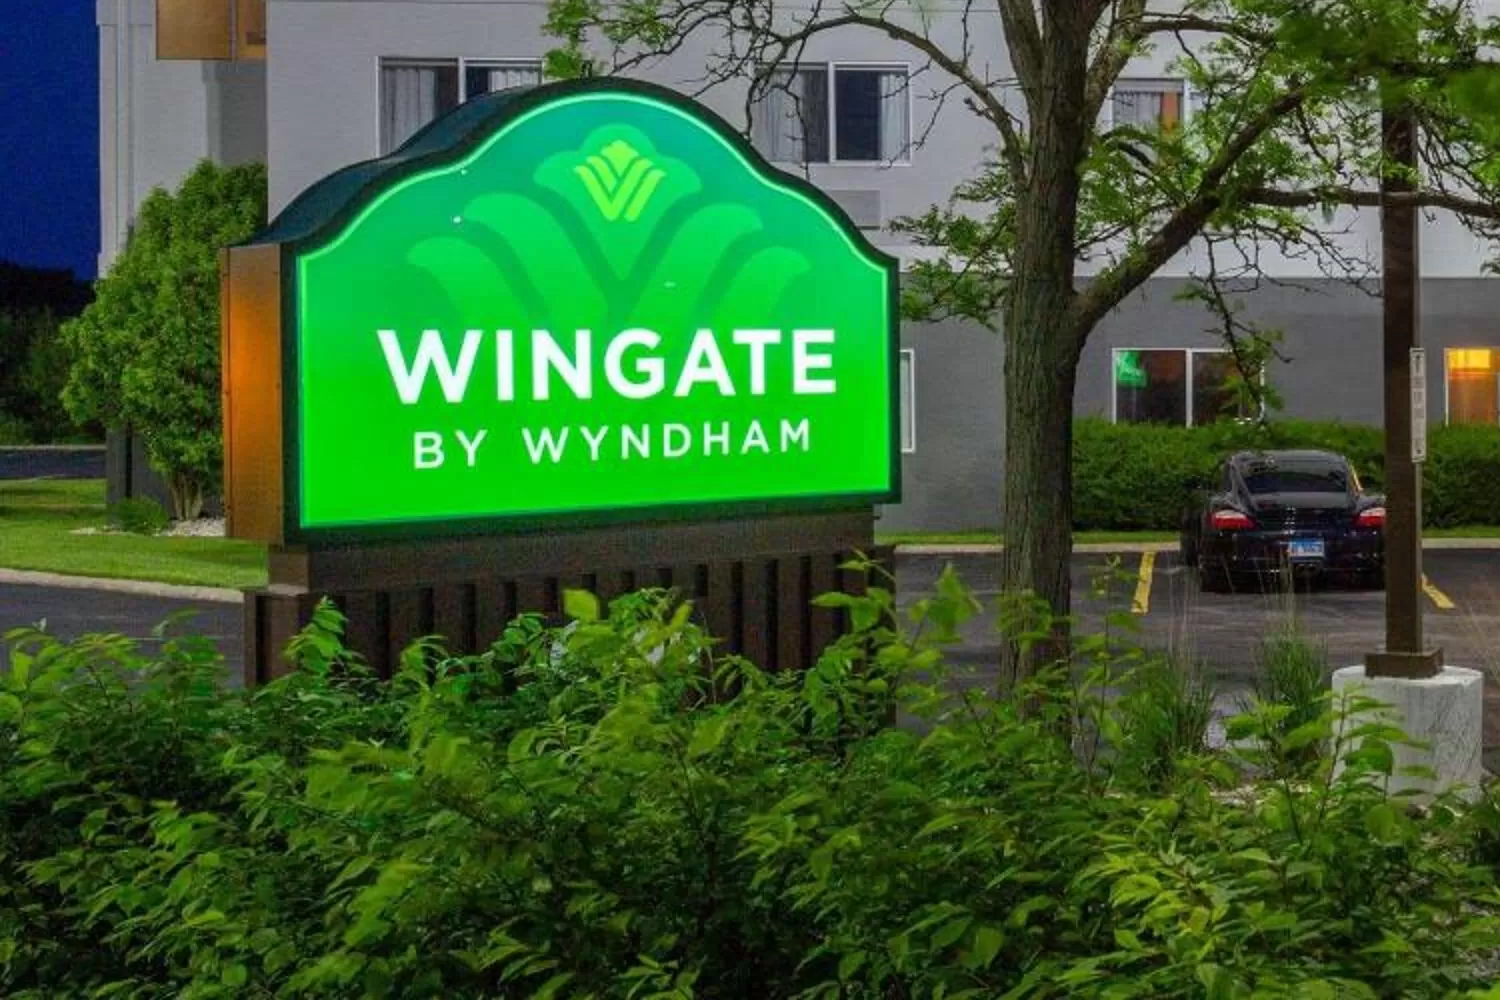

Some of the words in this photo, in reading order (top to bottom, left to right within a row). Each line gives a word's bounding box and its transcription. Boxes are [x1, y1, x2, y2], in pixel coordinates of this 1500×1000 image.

[377, 328, 837, 404] WINGATE
[413, 430, 487, 469] BY
[523, 418, 810, 464] WYNDHAM
